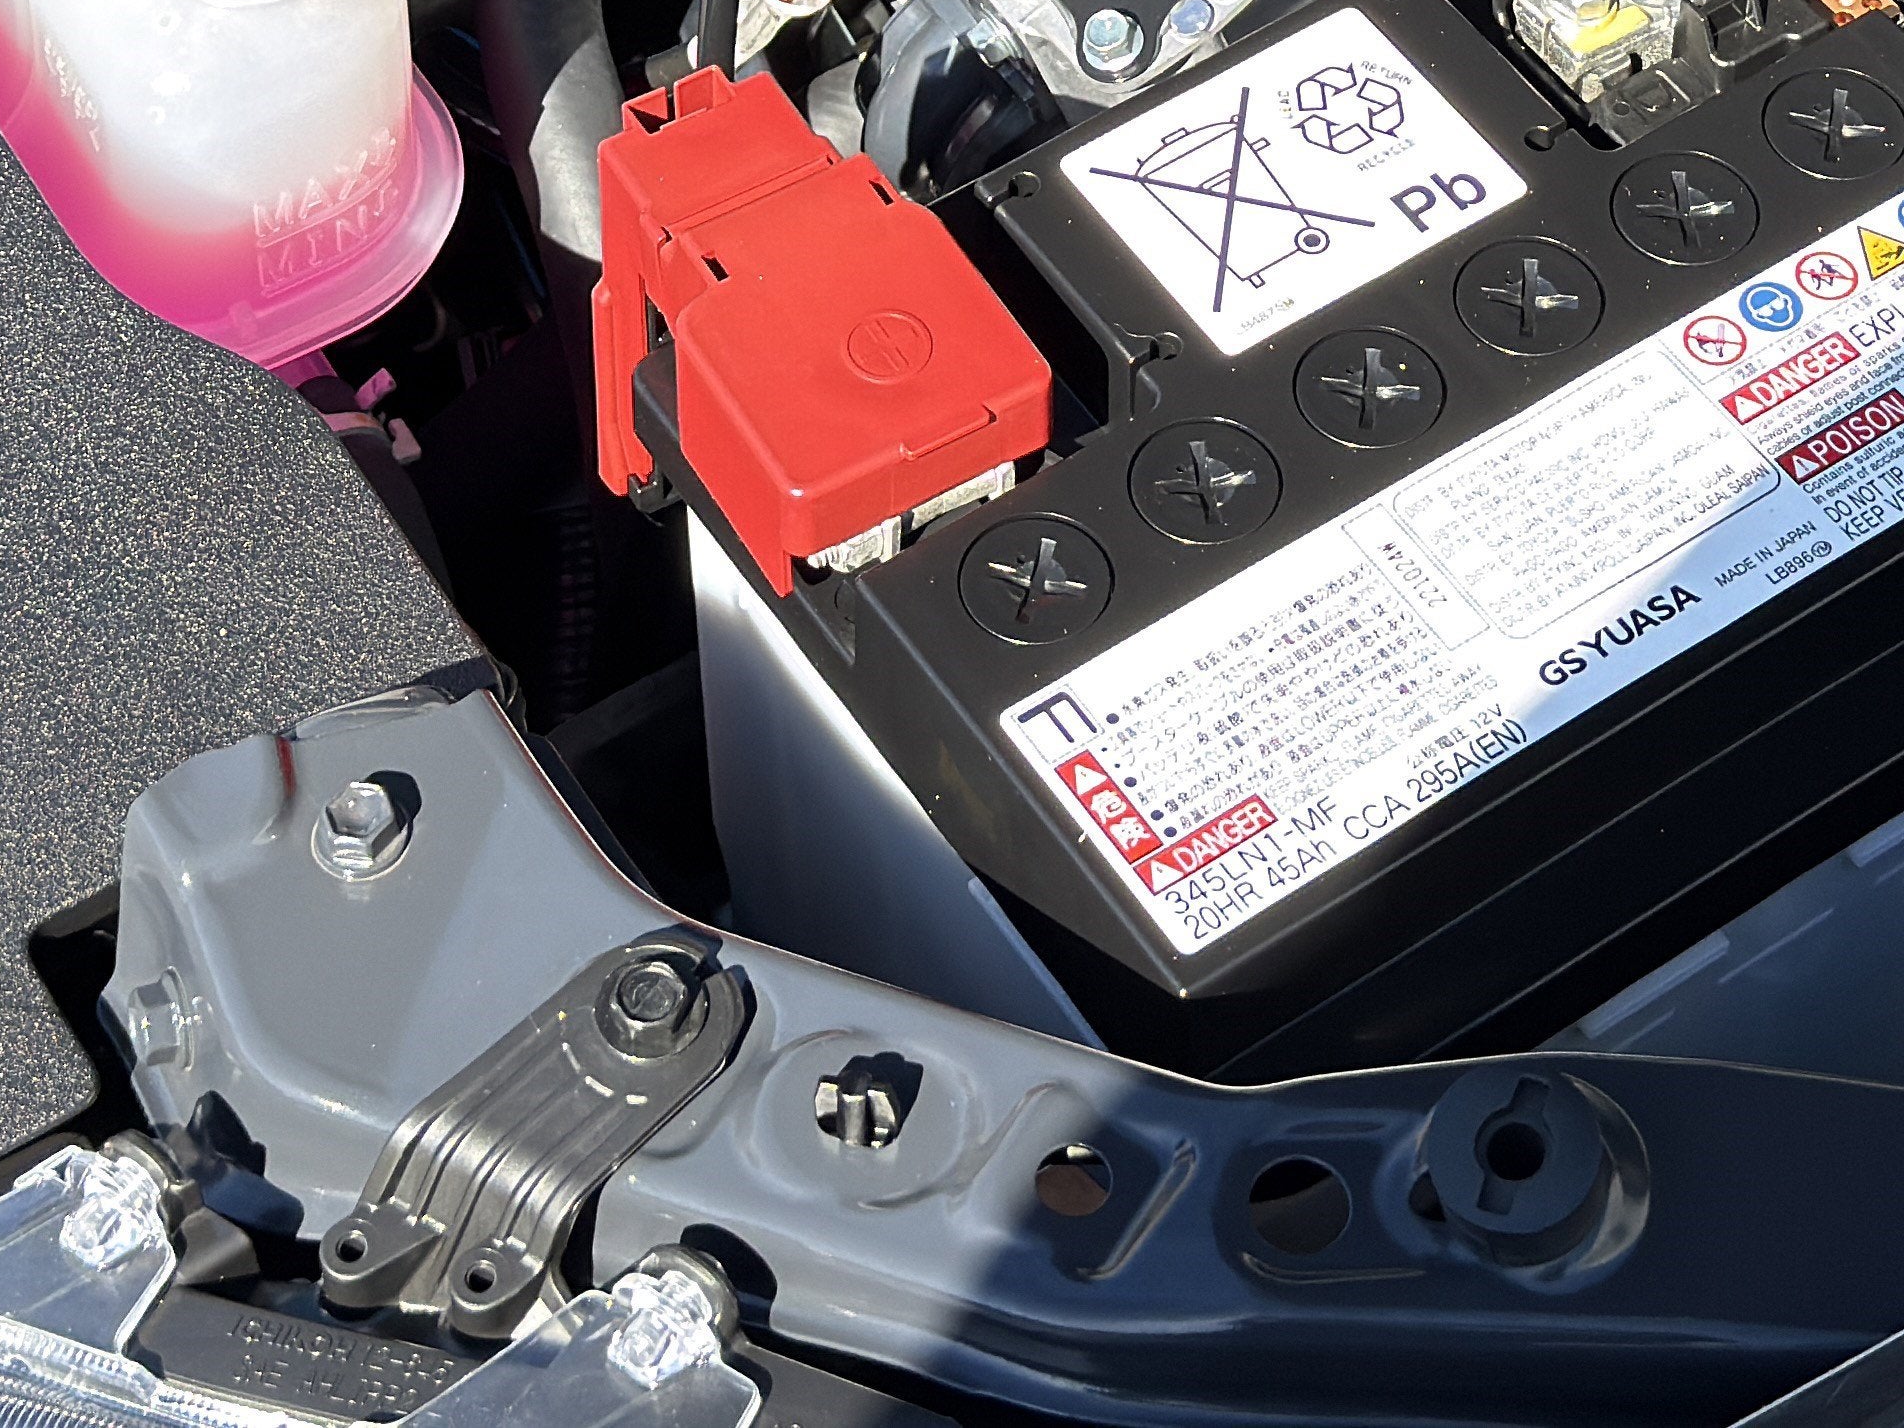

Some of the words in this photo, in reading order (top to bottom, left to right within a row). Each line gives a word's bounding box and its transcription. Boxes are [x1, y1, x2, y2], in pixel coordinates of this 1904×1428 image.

[1390, 173, 1487, 233] Pb
[1745, 334, 1857, 408] DANGER
[1822, 387, 1850, 407] eyes
[1847, 373, 1871, 392] and
[1866, 361, 1894, 380] face
[1861, 340, 1902, 367] sparks
[1765, 431, 1806, 460] cables
[1799, 423, 1819, 440] or
[1811, 404, 1851, 433] adjust
[1841, 390, 1874, 414] post
[1725, 462, 1772, 495] SAIPAN
[1801, 460, 1854, 499] Contains
[1852, 435, 1896, 468] sulfuric
[1809, 493, 1827, 506] In
[1824, 473, 1858, 498] event
[1855, 464, 1870, 480] of
[1821, 498, 1853, 524] DO
[1845, 478, 1884, 510] NOT
[1876, 464, 1904, 490] TIP
[1713, 555, 1757, 588] MADE
[1752, 545, 1774, 563] IN
[1773, 519, 1818, 553] JAPAN
[1837, 503, 1885, 541] KEEP
[1763, 549, 1814, 585] LB896
[1576, 583, 1703, 659] YUASA
[1084, 784, 1152, 853] 危険
[1170, 799, 1275, 875] DANGER
[1182, 880, 1264, 940] 20HR
[1266, 839, 1337, 887] 45Ah
[1342, 794, 1411, 840] CCA
[1405, 717, 1528, 803] 295A(EN)
[1163, 794, 1337, 915] 345LN1-MF
